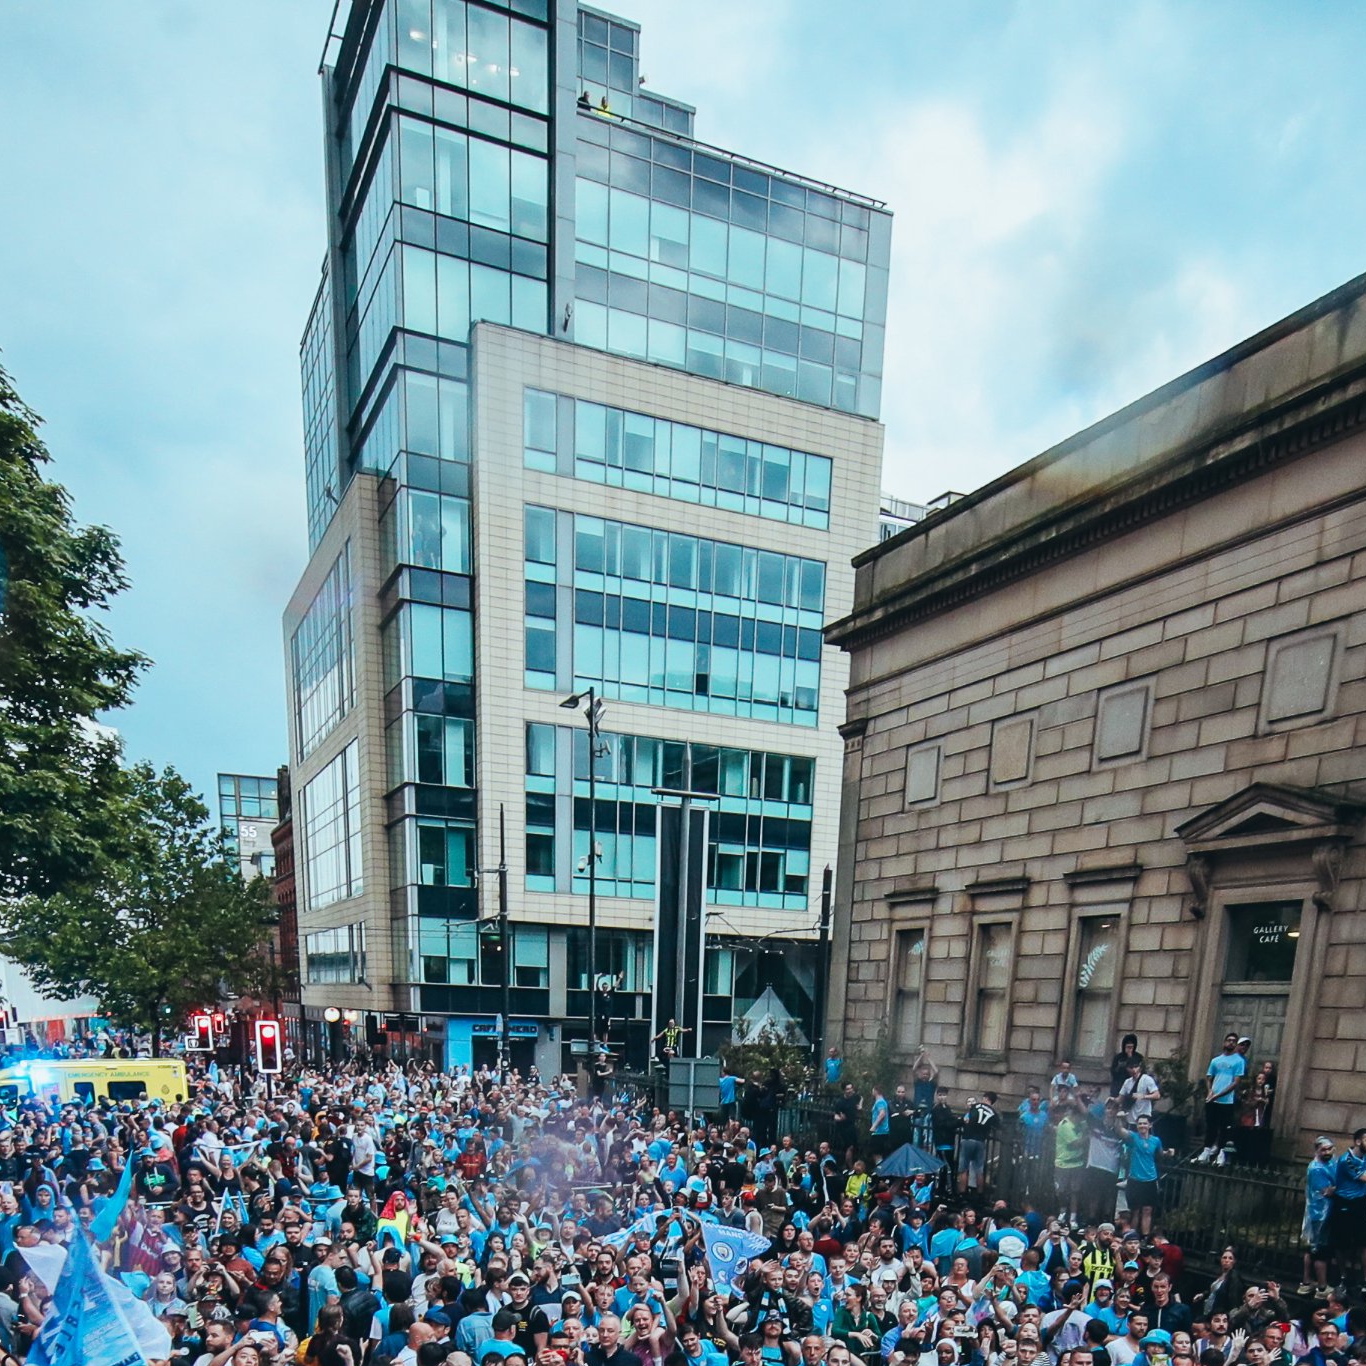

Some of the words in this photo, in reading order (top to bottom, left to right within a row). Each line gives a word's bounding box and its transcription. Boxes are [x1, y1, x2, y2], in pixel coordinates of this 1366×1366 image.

[240, 825, 258, 838] 55
[1253, 925, 1289, 934] GALLERY
[67, 1071, 108, 1079] EMERGENCY
[110, 1070, 150, 1078] AMBULANCE
[977, 1108, 995, 1125] 17
